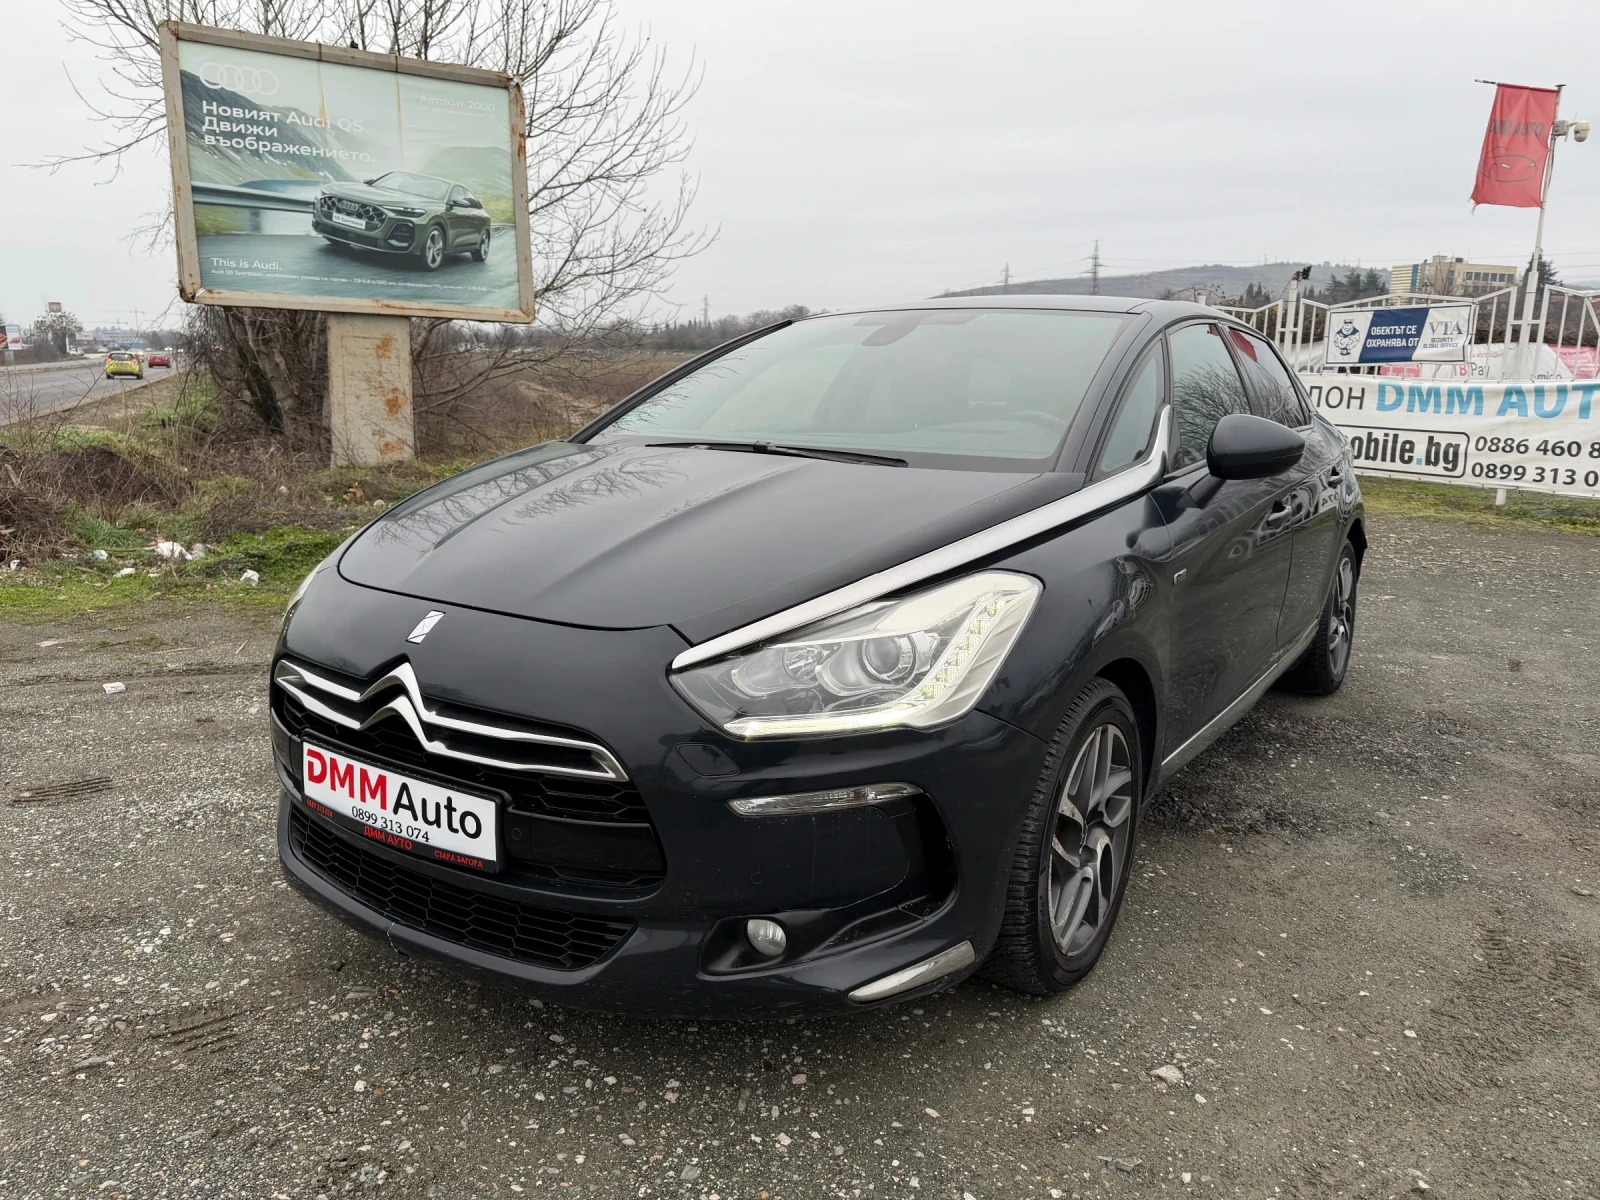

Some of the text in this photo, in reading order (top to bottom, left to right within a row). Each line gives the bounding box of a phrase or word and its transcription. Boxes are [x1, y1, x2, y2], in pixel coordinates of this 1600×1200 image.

[202, 100, 281, 123] Новият
[286, 111, 331, 129] Audi
[468, 101, 495, 112] 2000
[202, 116, 278, 137] Движи
[204, 135, 376, 162] въображението.
[211, 257, 282, 270] This is Audi.
[1371, 325, 1417, 335] ОБЕКТЪТ СЕ
[1428, 320, 1463, 335] VTA
[1366, 337, 1419, 348] ОХРАНЯВА ОТ
[1470, 362, 1490, 378] Pay
[1376, 380, 1484, 415] DMM
[1351, 432, 1461, 472] obile.bg
[1475, 436, 1529, 455] 0886
[1535, 439, 1582, 458] 460
[1471, 462, 1599, 487] 0899 313 0
[352, 806, 430, 843] 0899 313 074
[363, 825, 413, 851] ДММ АУТО
[434, 850, 484, 868] СТАРА ЗАГОРА
